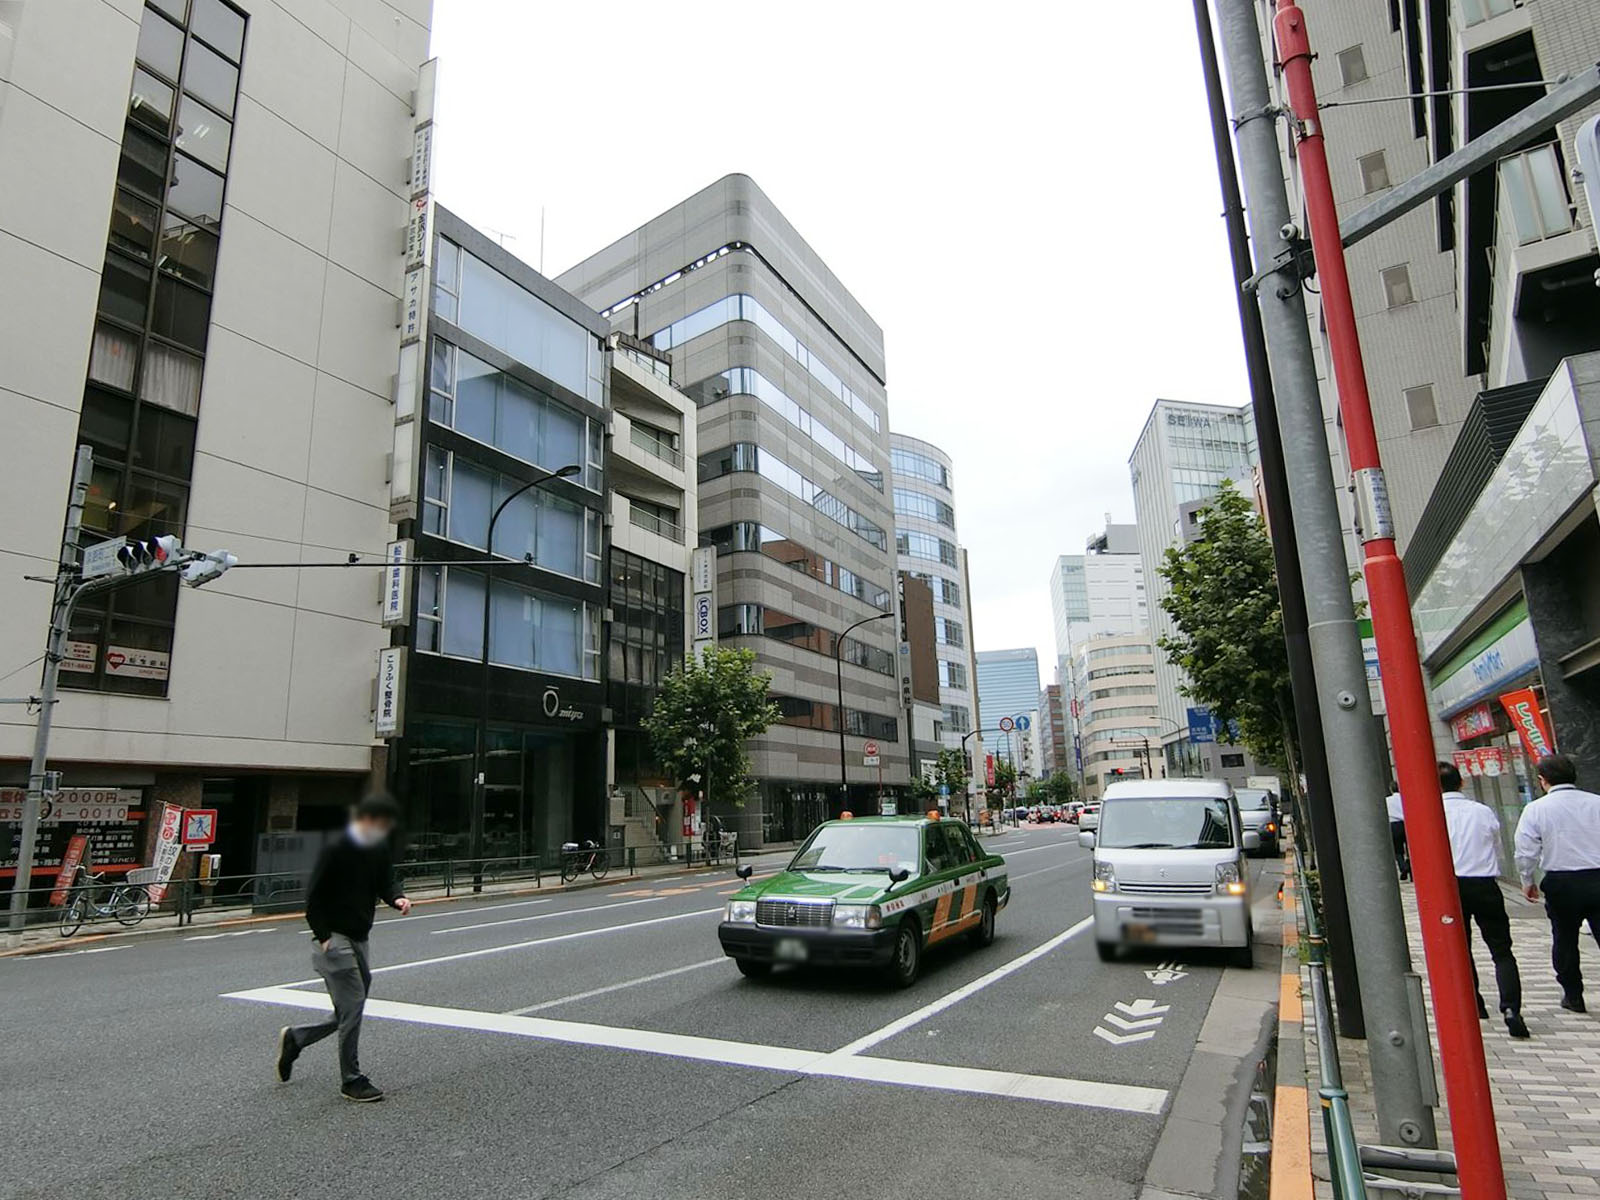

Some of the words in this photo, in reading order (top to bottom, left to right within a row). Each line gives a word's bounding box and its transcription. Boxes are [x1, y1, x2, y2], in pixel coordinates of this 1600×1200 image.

[1167, 414, 1211, 428] SEIWA
[700, 599, 709, 634] LCBOX
[382, 654, 394, 718] こうふく整骨院
[13, 807, 127, 820] 594-0010
